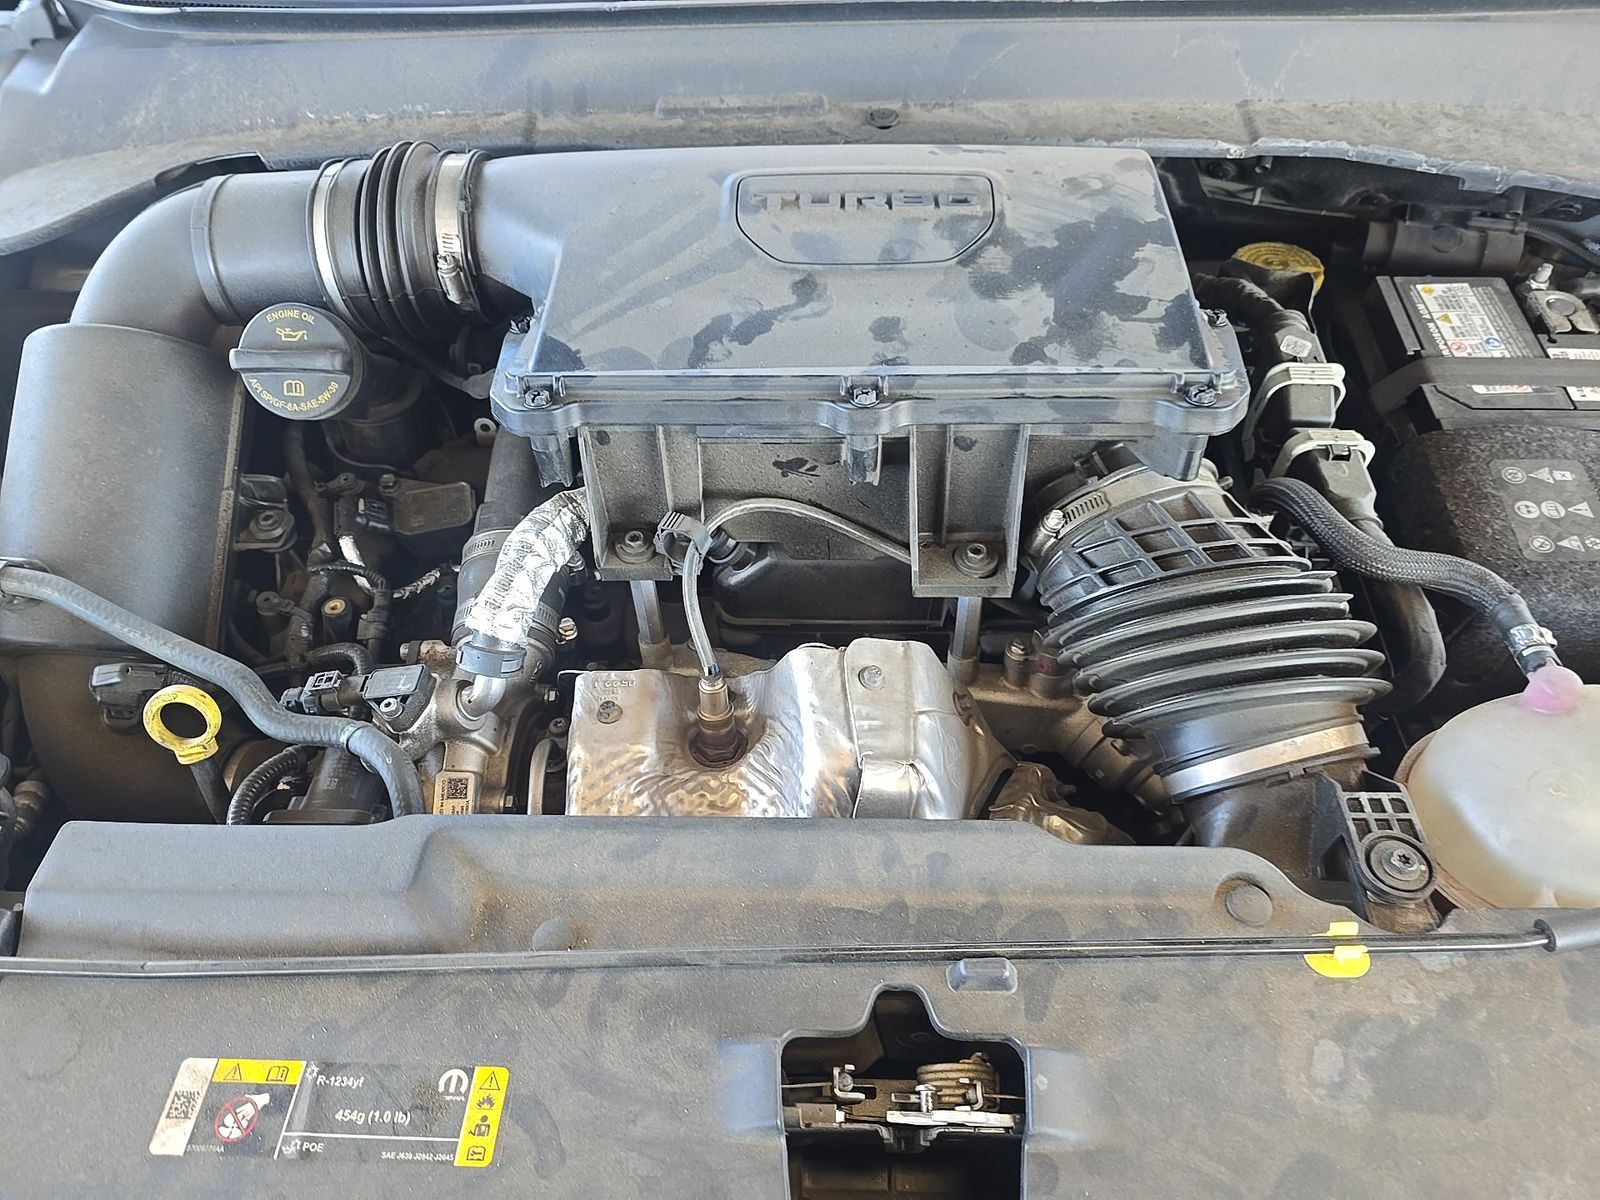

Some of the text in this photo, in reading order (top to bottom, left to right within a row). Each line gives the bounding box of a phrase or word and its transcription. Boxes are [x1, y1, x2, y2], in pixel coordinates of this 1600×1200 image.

[266, 309, 315, 325] ENGINE OIL
[249, 378, 263, 394] API
[316, 1074, 365, 1089] R-1234yf
[334, 1108, 411, 1126] 454g (1.0 lb)
[302, 1141, 324, 1153] POE
